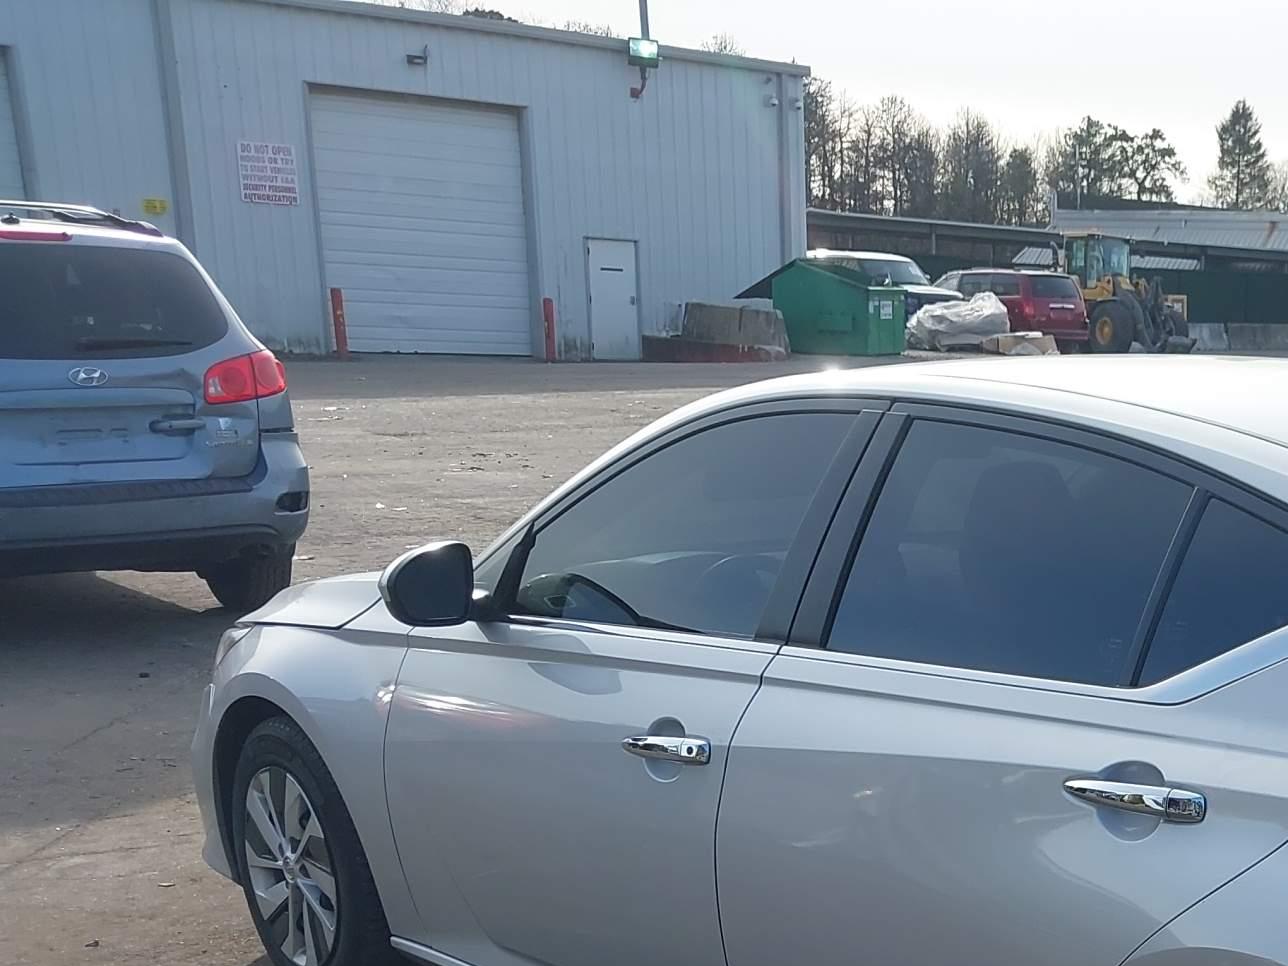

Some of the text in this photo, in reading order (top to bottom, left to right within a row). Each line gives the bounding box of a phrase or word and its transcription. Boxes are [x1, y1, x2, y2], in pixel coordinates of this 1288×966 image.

[240, 143, 292, 156] DO NOT OPEN
[268, 157, 278, 165] OR
[281, 158, 294, 166] TRY
[240, 164, 249, 172] TO
[250, 165, 268, 174] START
[242, 174, 278, 183] WITHOUT
[243, 183, 267, 192] SECURITY
[244, 192, 298, 203] AUTHORIZATION
